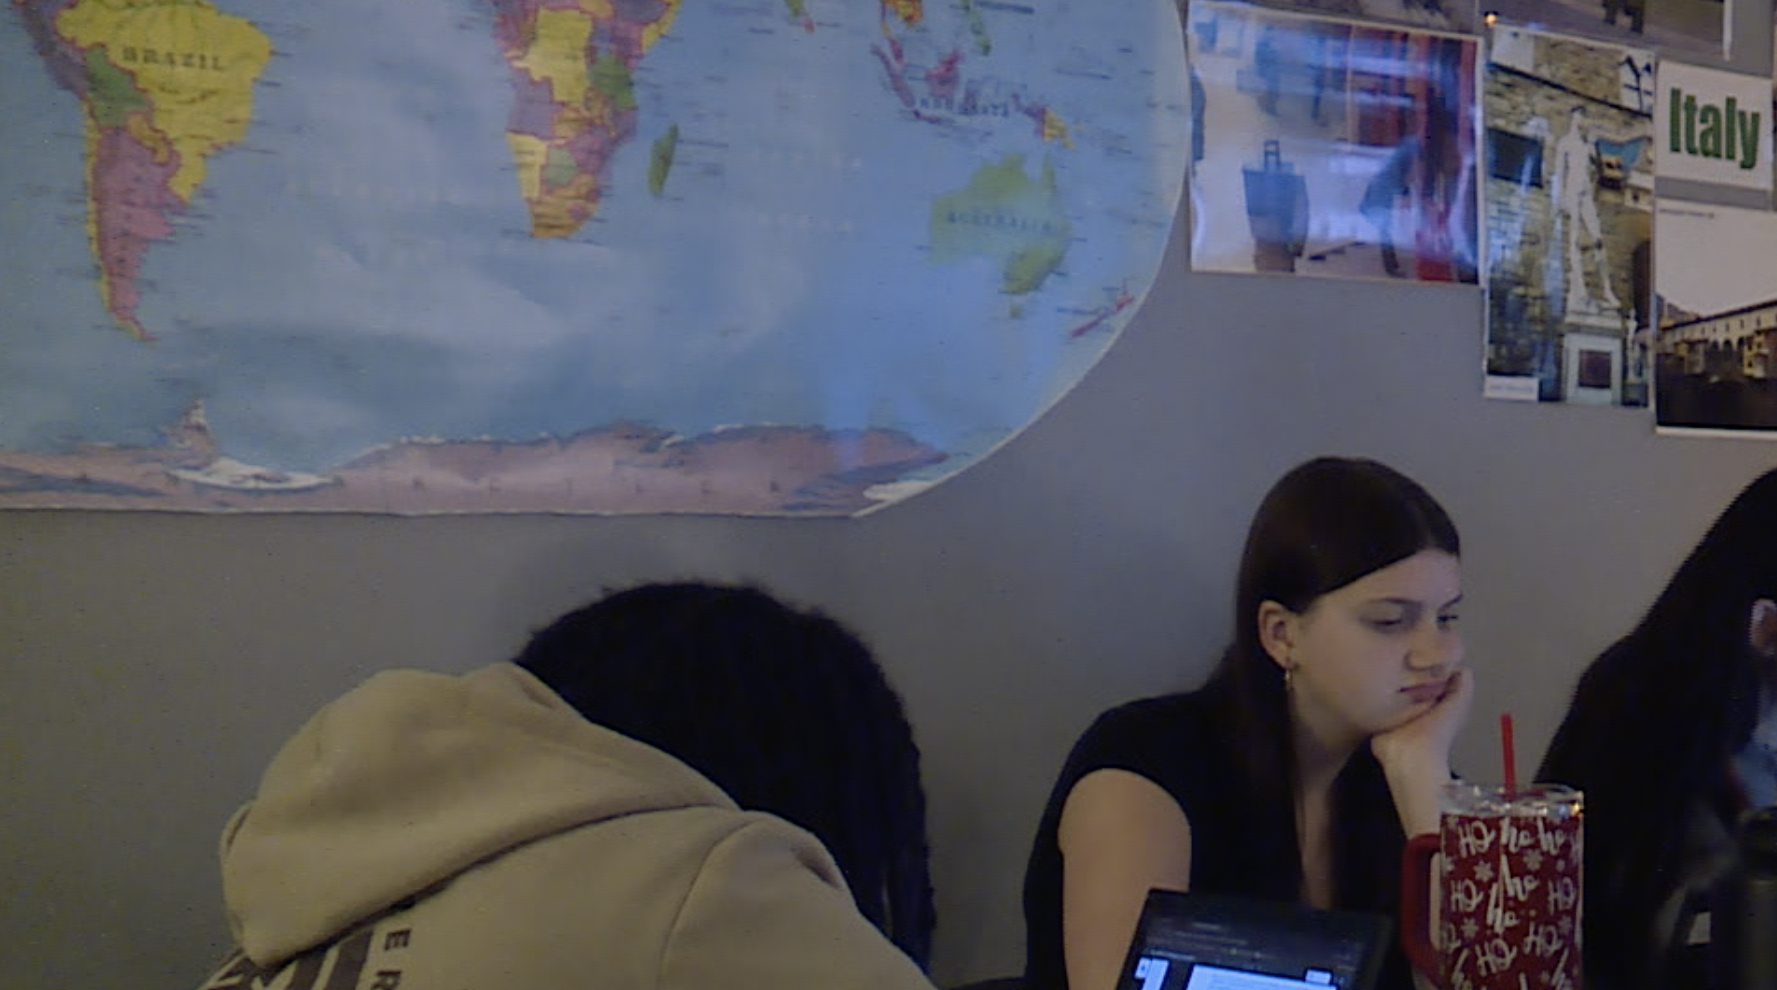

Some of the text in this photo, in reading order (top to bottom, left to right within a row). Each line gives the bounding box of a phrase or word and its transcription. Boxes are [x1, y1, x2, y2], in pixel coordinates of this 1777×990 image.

[122, 46, 225, 71] BRAZIL
[1669, 86, 1761, 170] Italy
[1458, 820, 1496, 858] HO
[1500, 816, 1534, 853] ho
[1537, 816, 1566, 855] ho
[1451, 879, 1484, 912] HO
[1501, 854, 1540, 901] ho
[1486, 882, 1520, 934] ho
[1475, 938, 1517, 976] HO
